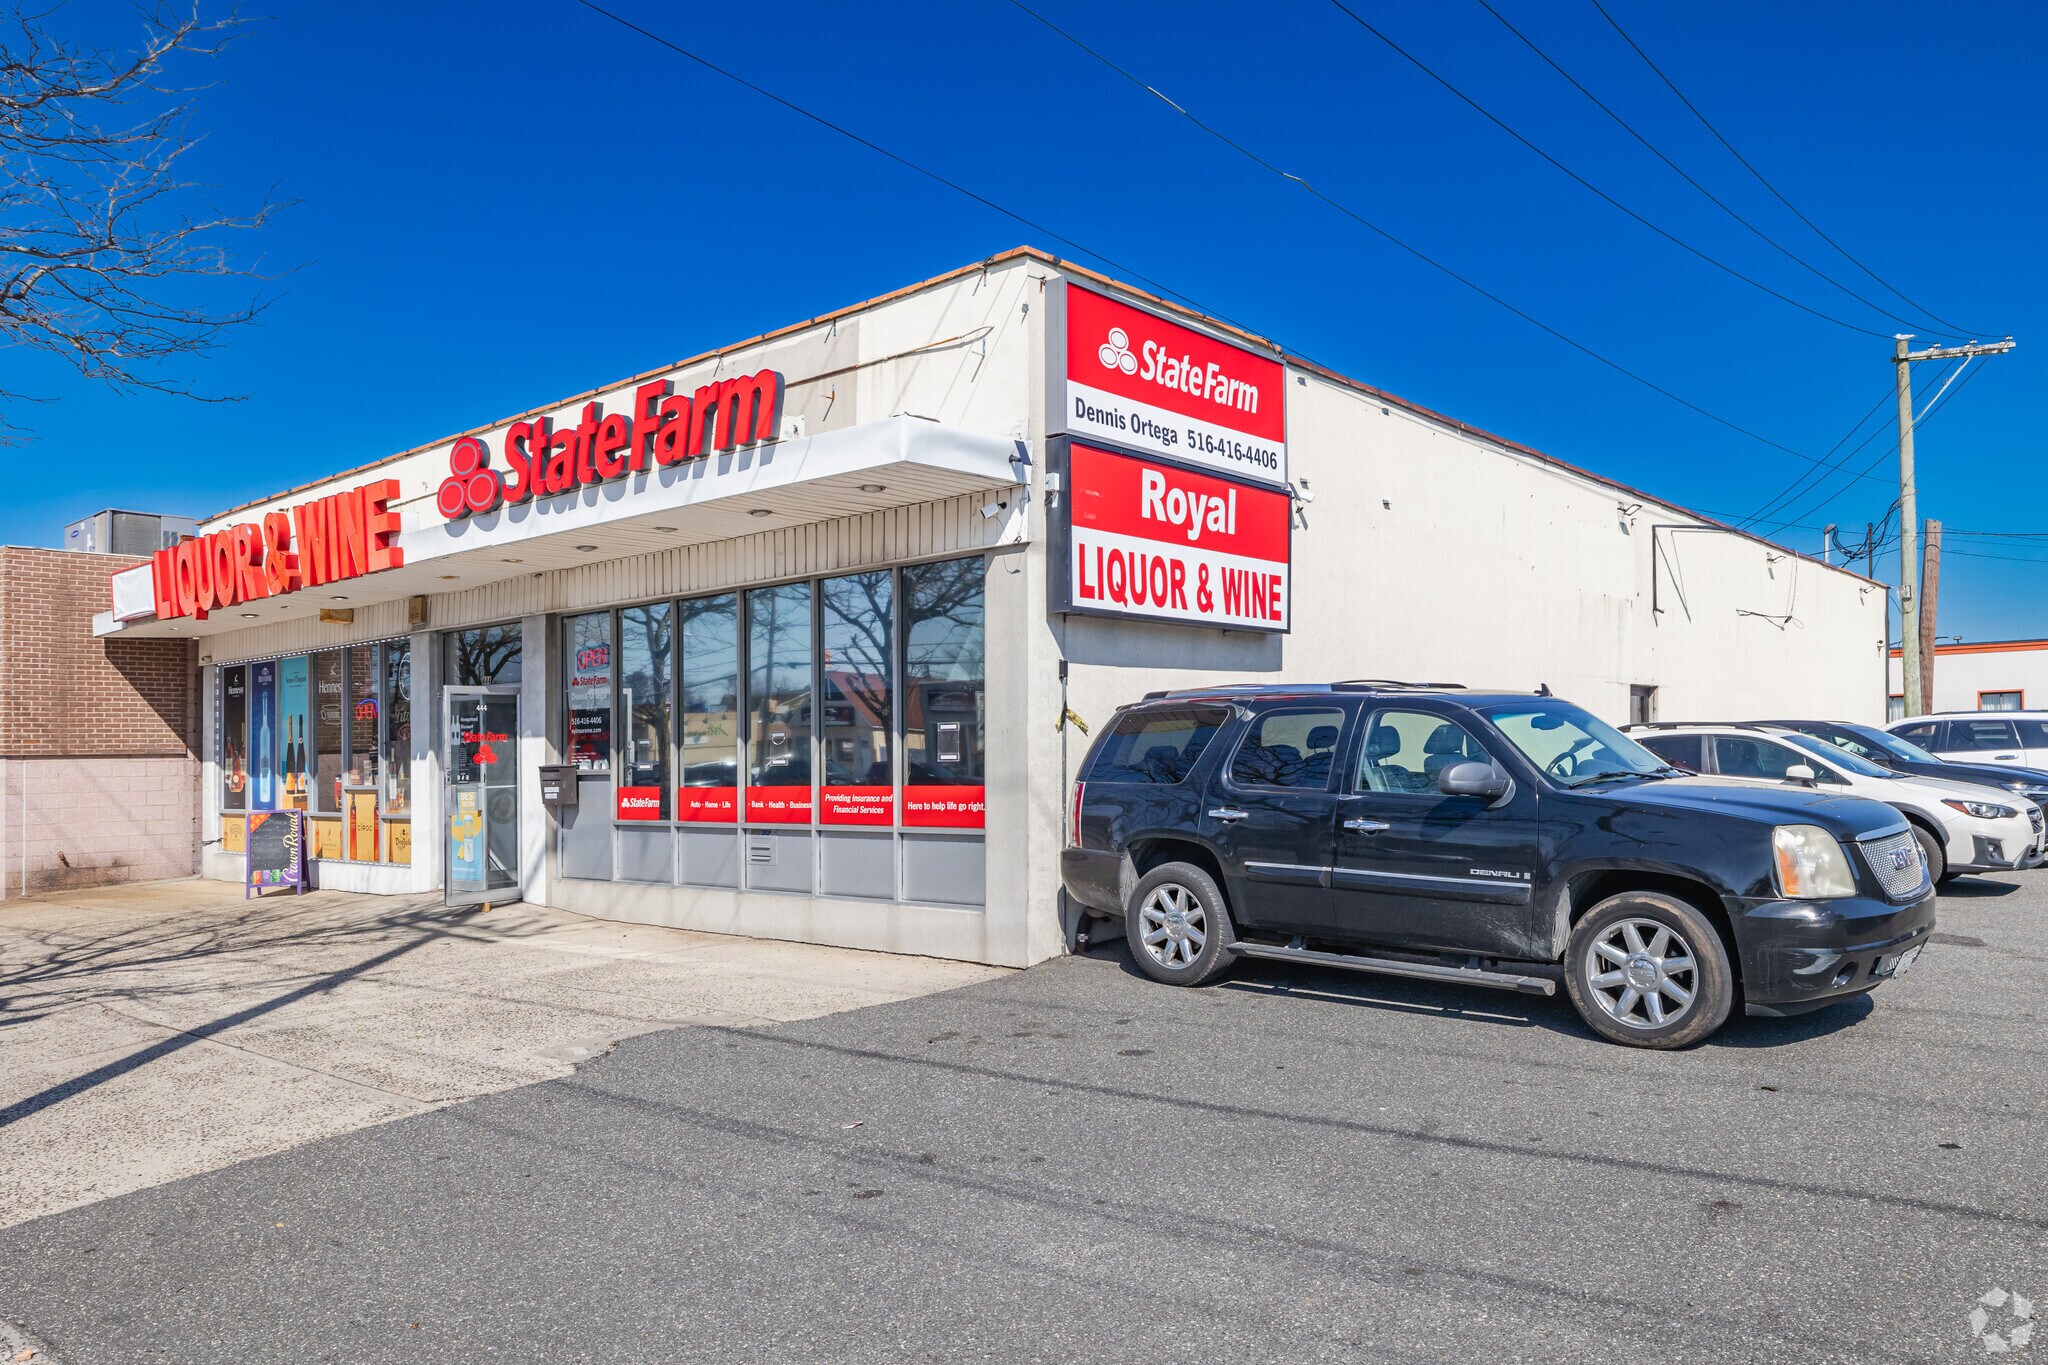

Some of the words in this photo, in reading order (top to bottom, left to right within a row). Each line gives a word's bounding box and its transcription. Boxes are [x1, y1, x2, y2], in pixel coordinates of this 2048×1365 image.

[1075, 396, 1127, 431] Dennis
[1130, 412, 1178, 446] Ortega
[1187, 429, 1278, 470] 516-416-4406
[1141, 468, 1237, 541] Royal
[153, 523, 267, 620] LIQUOR
[265, 511, 302, 594] &
[294, 479, 404, 586] WINE
[1079, 543, 1188, 611] LIQUOR
[1197, 562, 1214, 614] &
[1221, 566, 1282, 622] WINE
[577, 647, 607, 670] OPEN
[476, 704, 488, 712] 444
[825, 793, 851, 804] Providing
[852, 794, 880, 803] Insurance
[881, 794, 893, 803] and
[690, 800, 701, 808] Auto
[704, 801, 719, 809] Home
[722, 801, 731, 809] Life
[751, 800, 764, 808] Bank
[768, 801, 785, 809] Health
[789, 801, 812, 809] Business
[833, 805, 859, 814] Financial
[859, 806, 884, 814] Services
[907, 801, 922, 811] Here
[923, 802, 931, 811] to
[931, 802, 945, 812] help
[946, 801, 957, 811] life
[958, 803, 967, 812] go
[1469, 868, 1520, 879] DENALI
